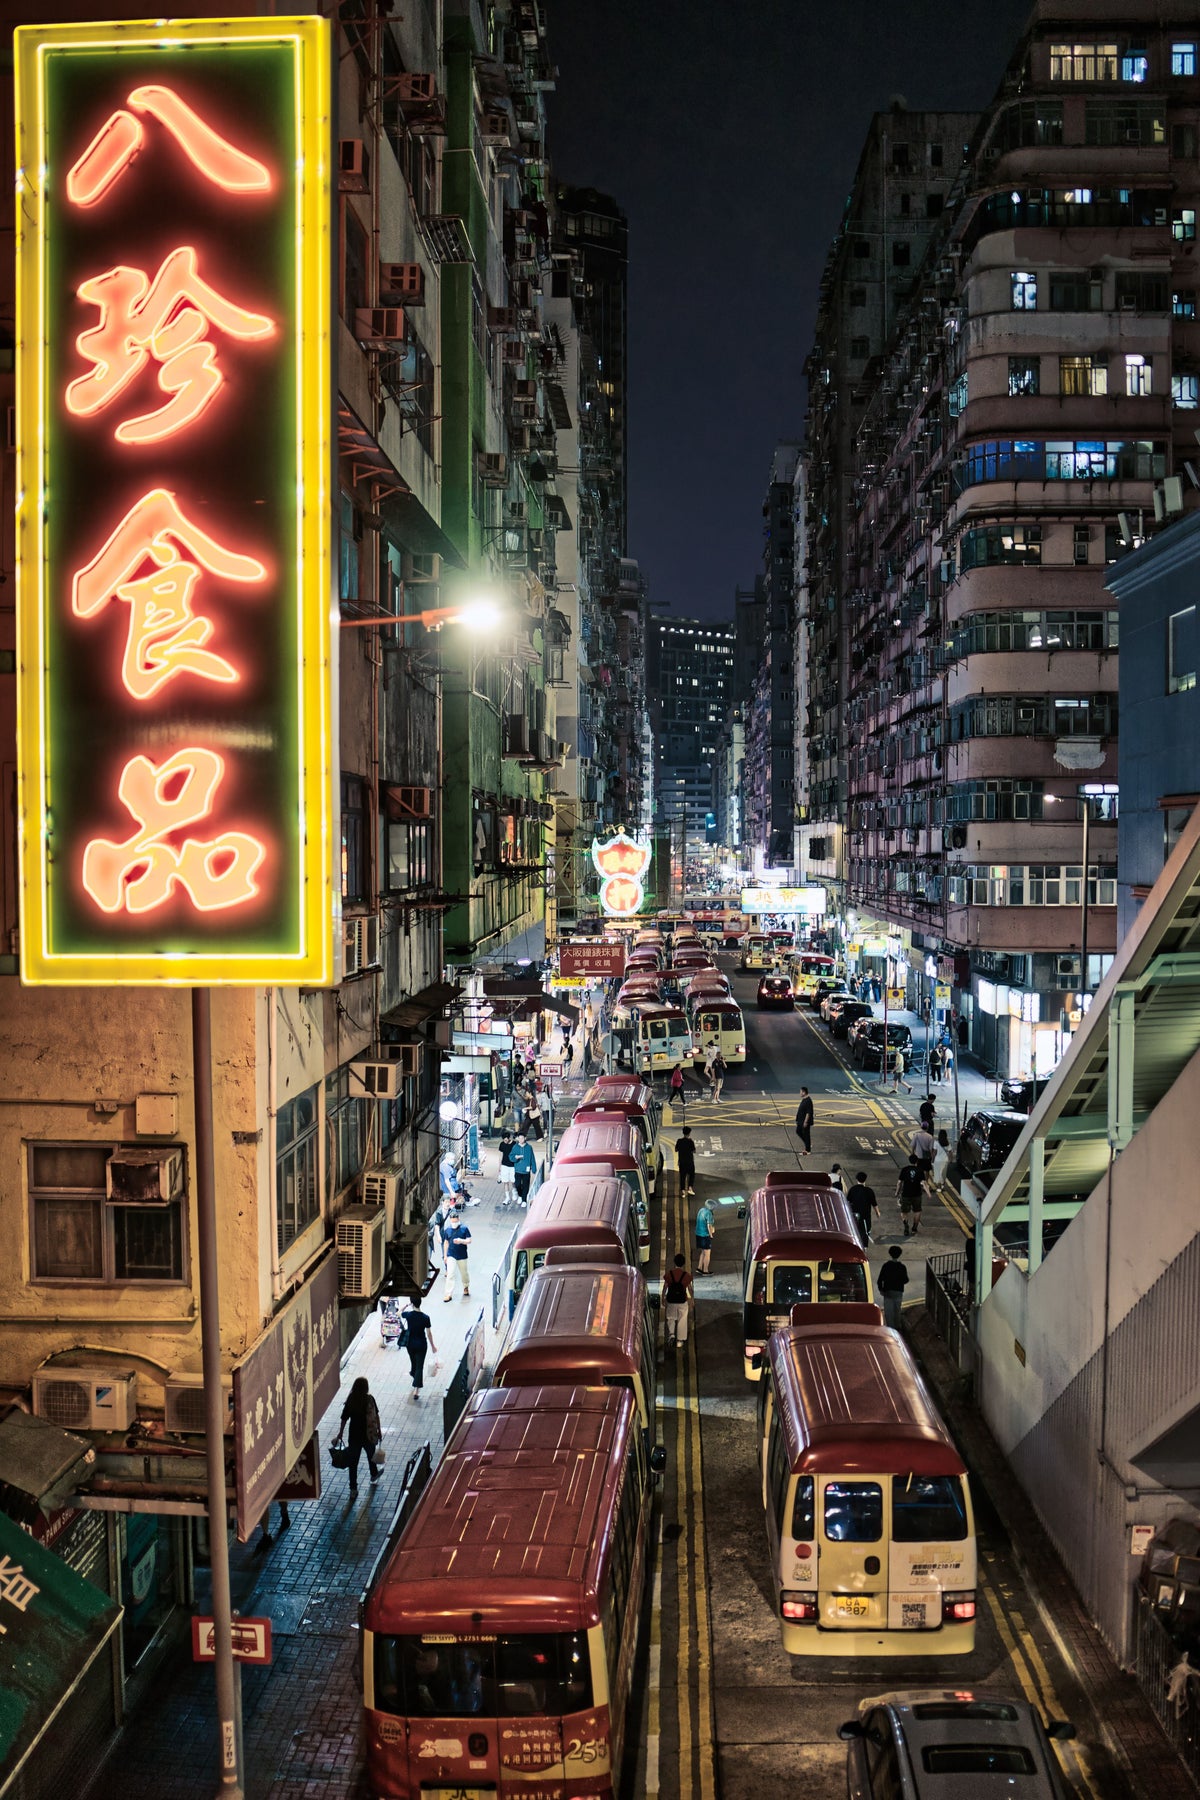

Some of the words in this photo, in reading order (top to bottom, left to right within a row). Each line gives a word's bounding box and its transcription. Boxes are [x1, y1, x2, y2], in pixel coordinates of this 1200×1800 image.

[66, 84, 275, 914] 八珍食品
[563, 947, 620, 958] 大阪鐘錶珠寶
[574, 959, 590, 967] 高價
[594, 959, 611, 967] 收購
[846, 1597, 860, 1606] GA
